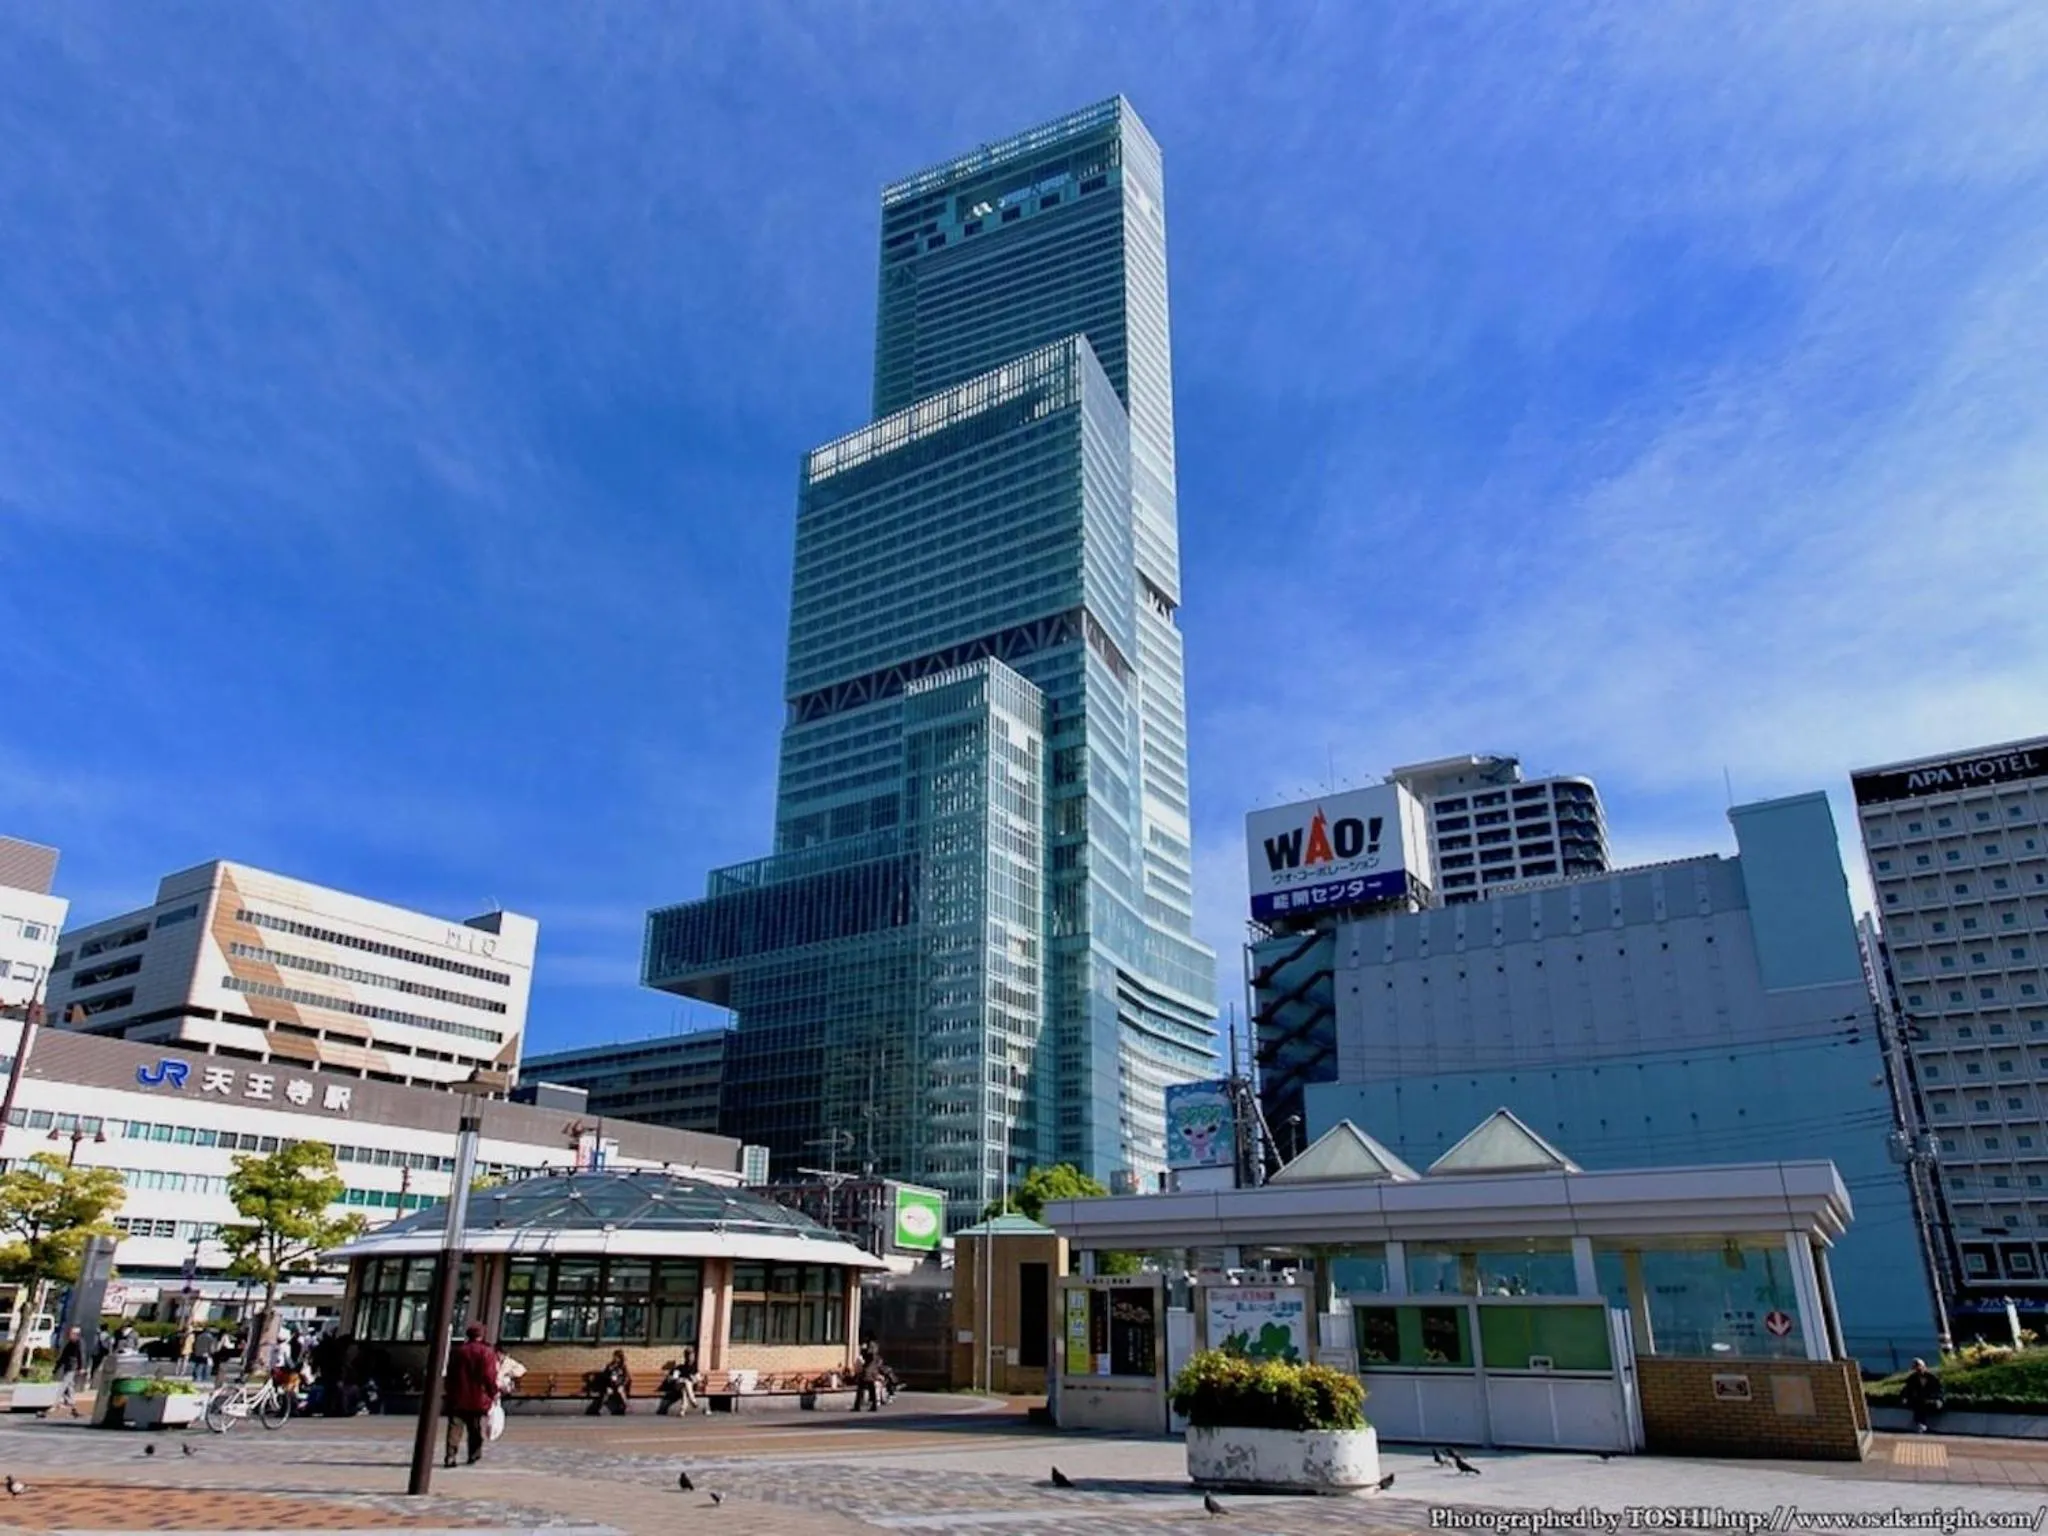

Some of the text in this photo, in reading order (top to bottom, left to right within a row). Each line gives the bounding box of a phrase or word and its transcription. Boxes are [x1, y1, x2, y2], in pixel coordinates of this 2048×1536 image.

[1907, 753, 2040, 789] APA HOTEL
[1263, 803, 1384, 873] WAO!
[135, 1057, 353, 1112] JR 天王寺駅
